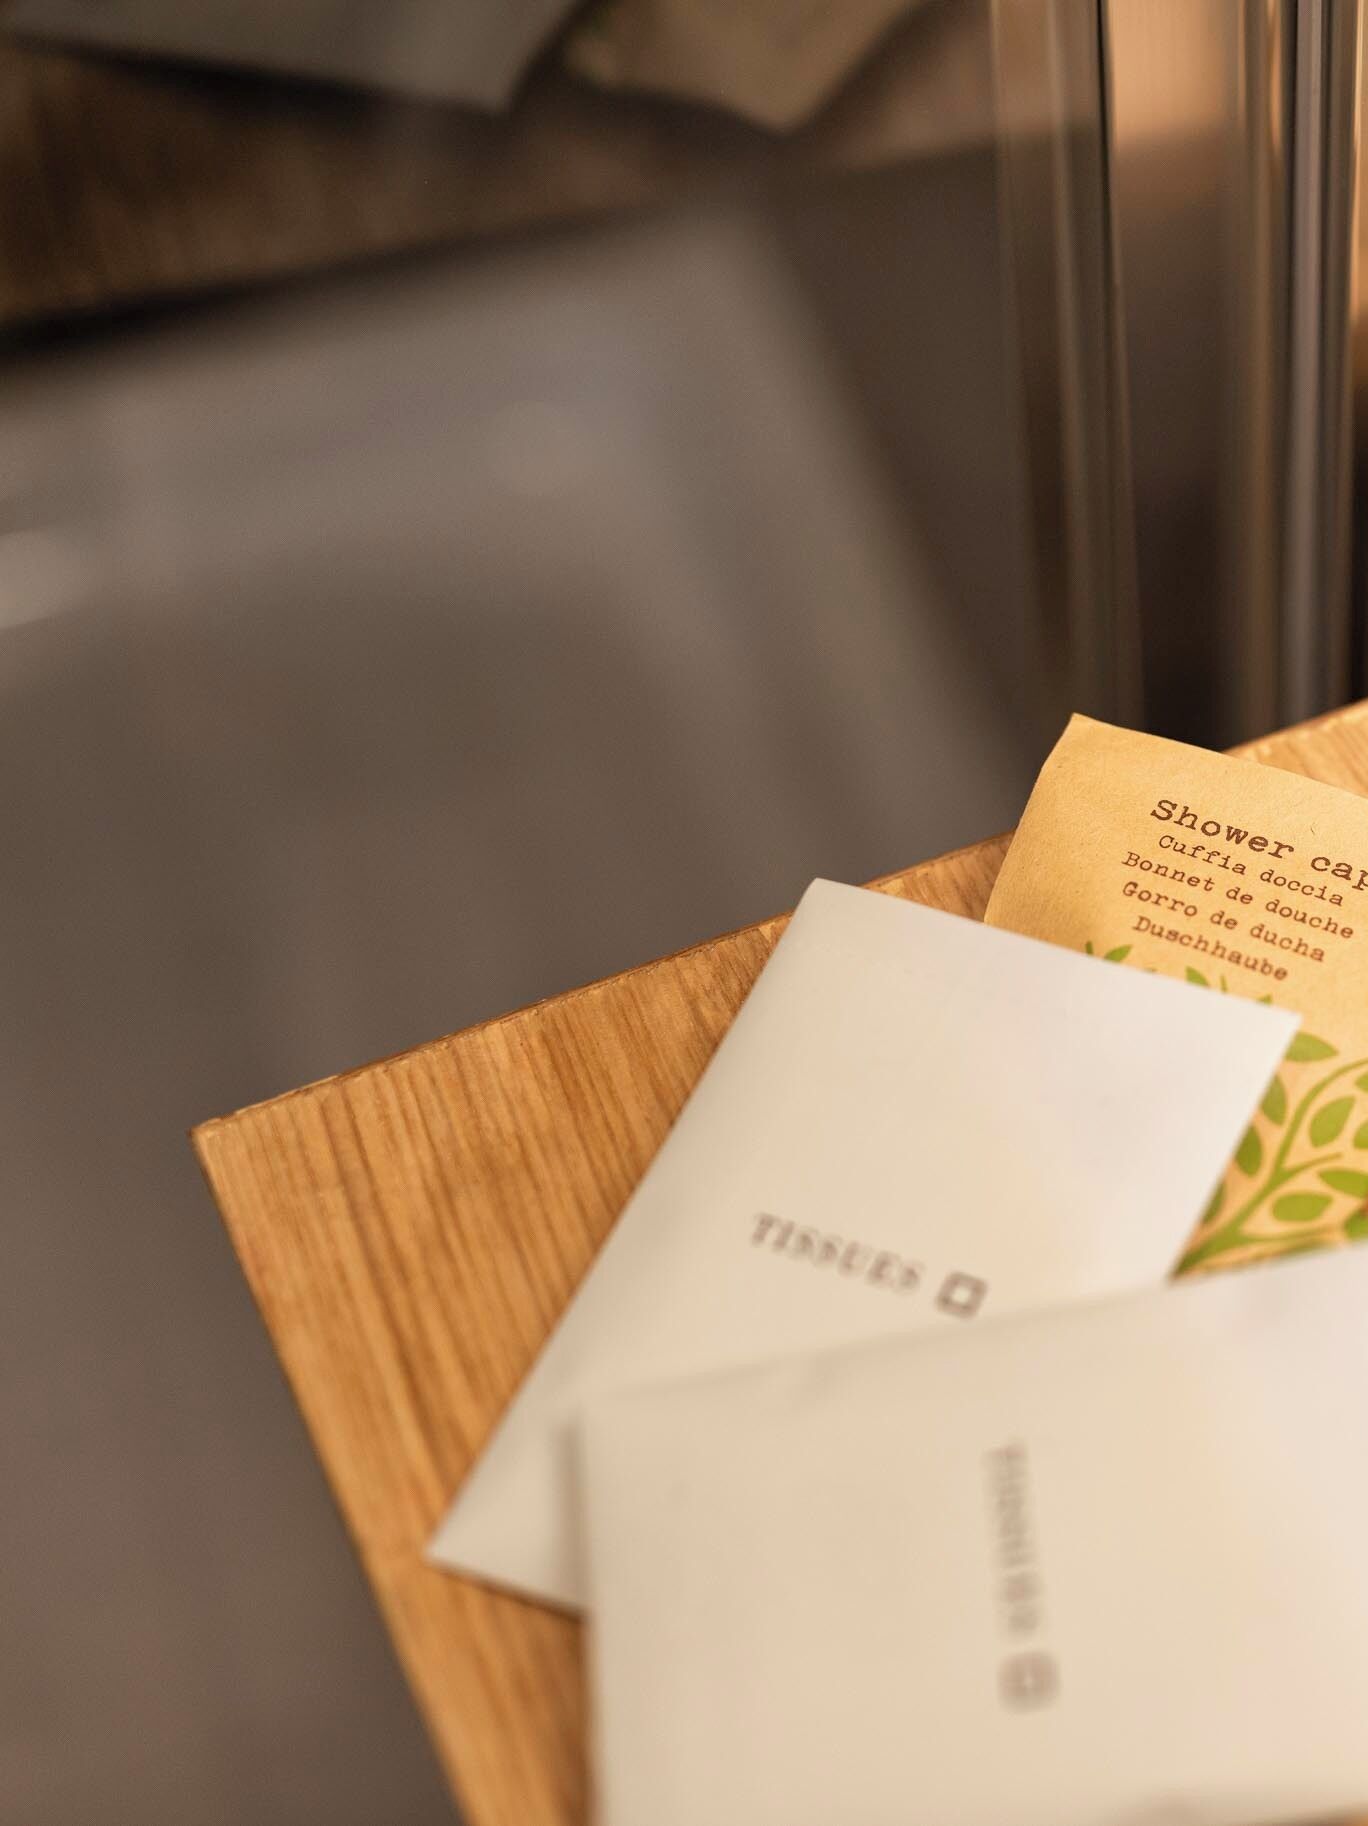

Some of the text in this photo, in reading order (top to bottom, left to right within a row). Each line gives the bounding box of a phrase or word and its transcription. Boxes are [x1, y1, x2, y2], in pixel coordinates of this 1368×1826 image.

[1150, 799, 1294, 859] Shower
[1121, 850, 1354, 939] Bonnet de douche
[1158, 834, 1344, 906] Cuffia doccia
[1122, 881, 1326, 962] Gorro de ducha
[1132, 915, 1289, 980] Duschhaube
[751, 1212, 926, 1296] TISSUES
